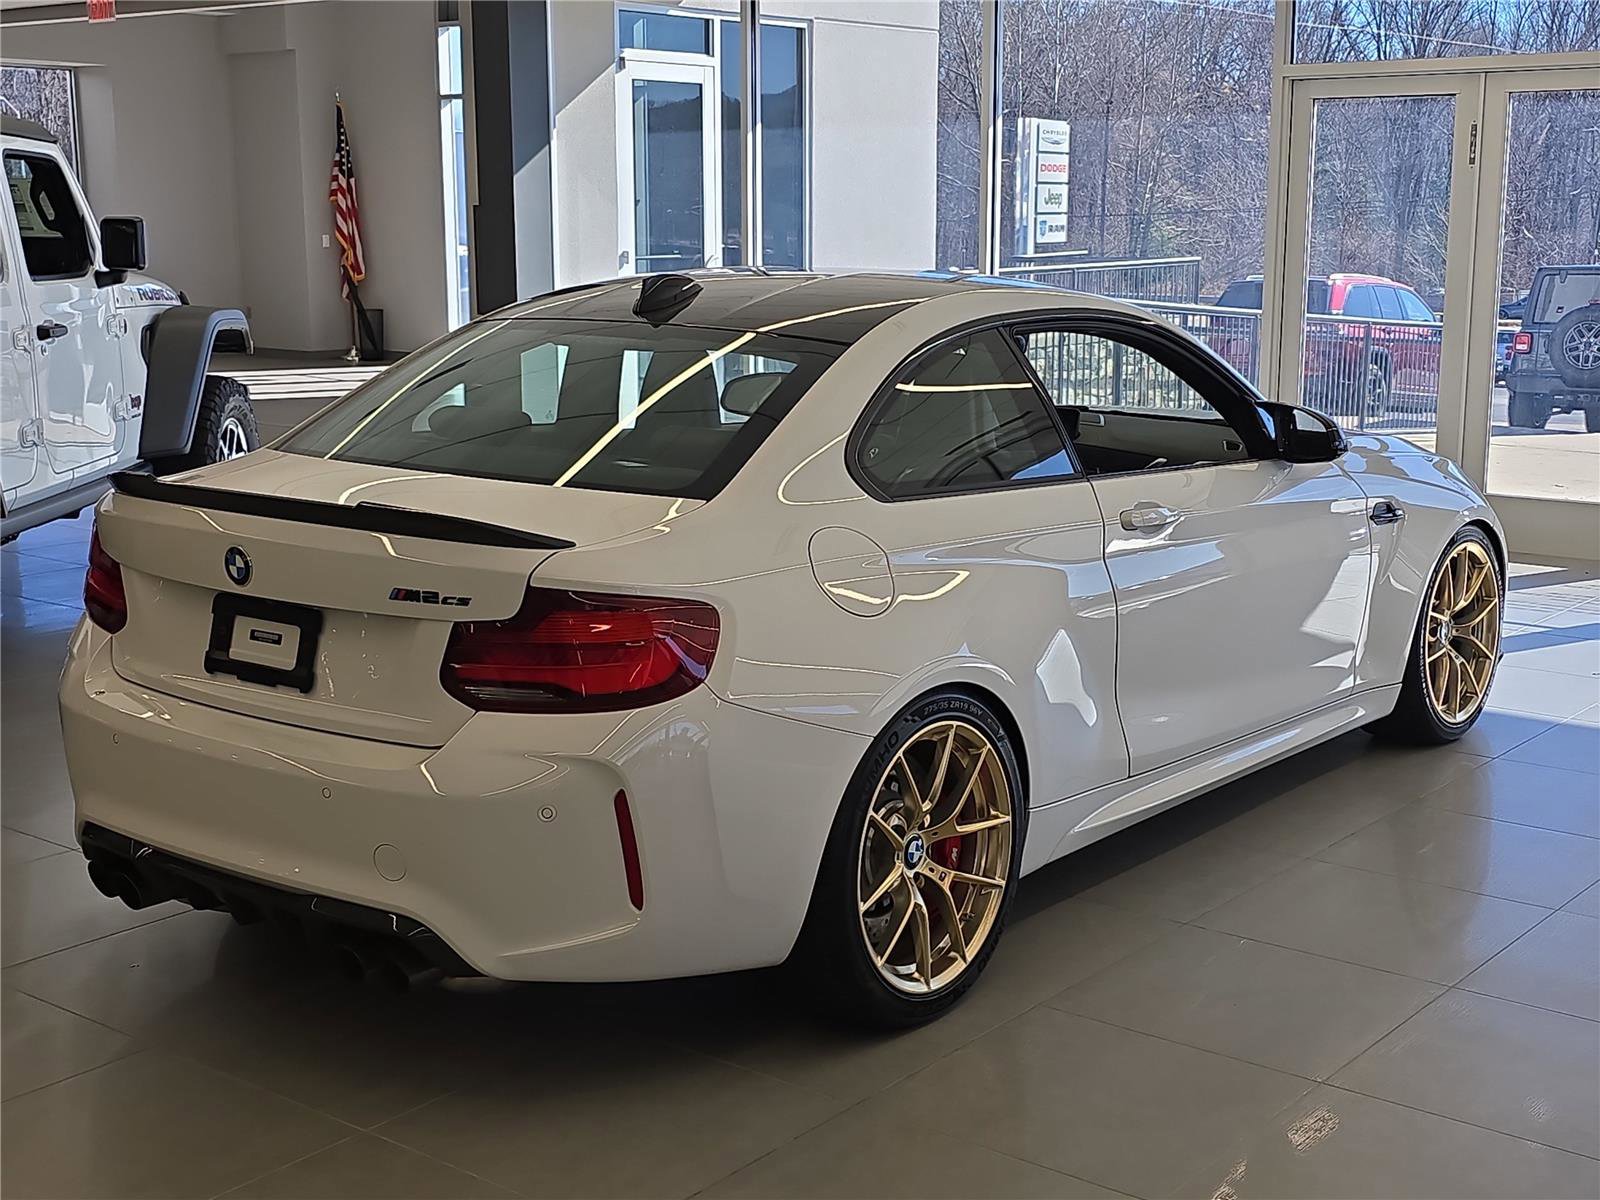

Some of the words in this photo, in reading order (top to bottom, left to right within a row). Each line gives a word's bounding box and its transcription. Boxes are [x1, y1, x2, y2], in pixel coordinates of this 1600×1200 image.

[1040, 163, 1066, 173] DODGE
[1044, 188, 1062, 209] Jeep
[1047, 224, 1065, 233] RAM
[923, 701, 948, 715] 275/35
[949, 701, 969, 711] ZR19
